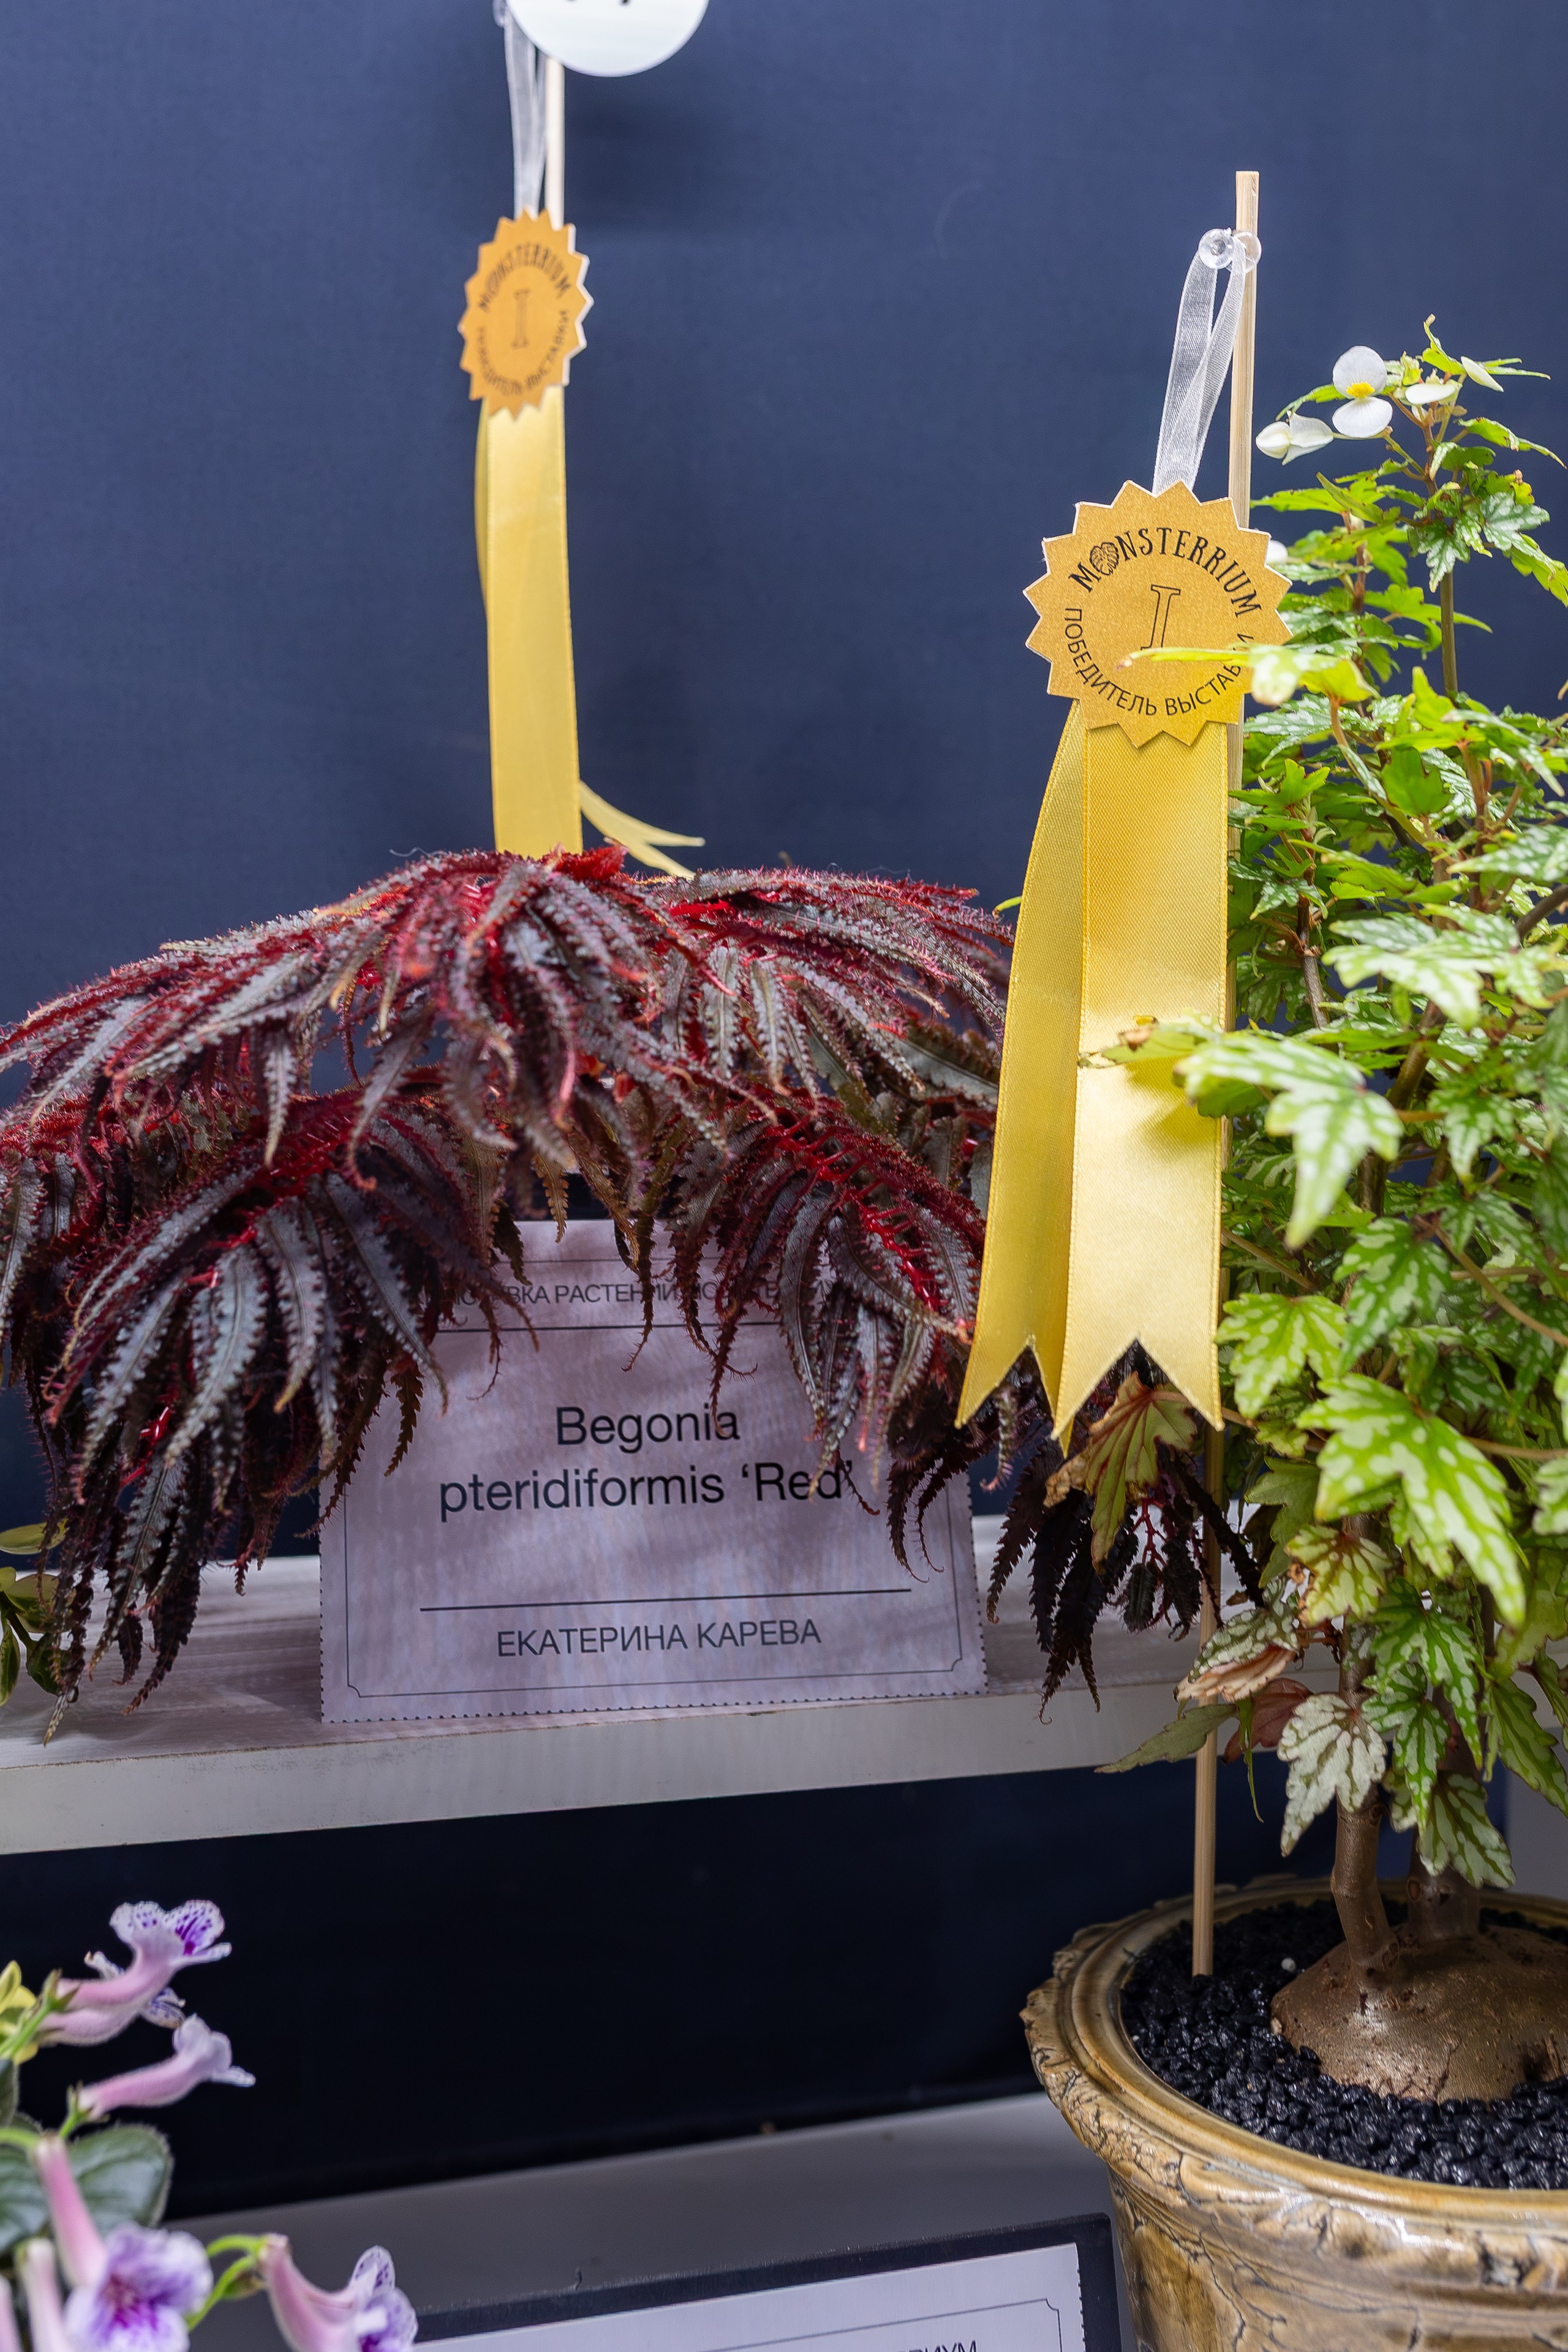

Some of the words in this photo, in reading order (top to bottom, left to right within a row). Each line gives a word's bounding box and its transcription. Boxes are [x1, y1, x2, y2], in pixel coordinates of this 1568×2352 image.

[1064, 608, 1157, 716] ПОБЕДИТЕЛЬ
[1165, 633, 1254, 716] ВЫСТАВИ
[556, 1403, 739, 1453] Begonia
[440, 1465, 725, 1523] pteridiformis
[497, 1624, 688, 1657] ЕКАТЕРИНА
[696, 1618, 822, 1649] КАРЕВА
